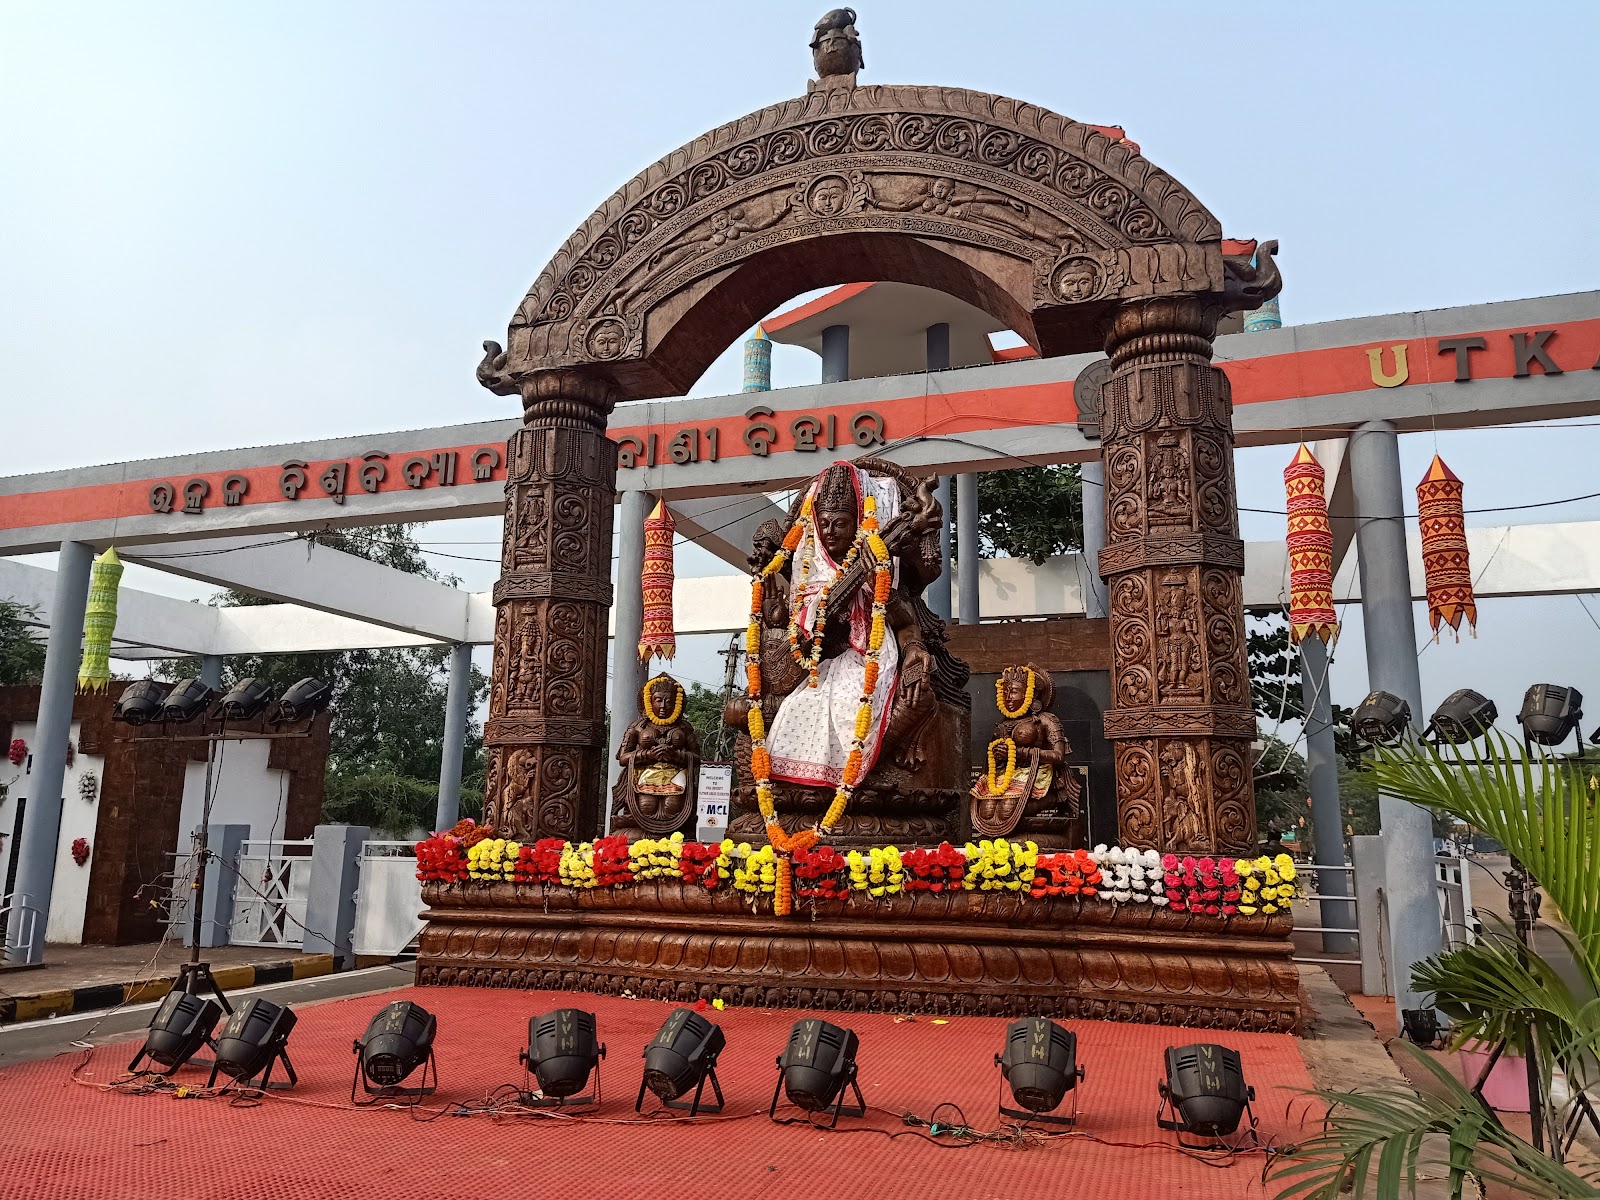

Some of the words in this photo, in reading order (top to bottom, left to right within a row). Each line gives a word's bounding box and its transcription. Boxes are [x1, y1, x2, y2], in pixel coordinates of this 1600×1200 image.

[1366, 330, 1600, 388] UTK
[743, 405, 886, 457] ବିହାର
[706, 804, 728, 815] MCL
